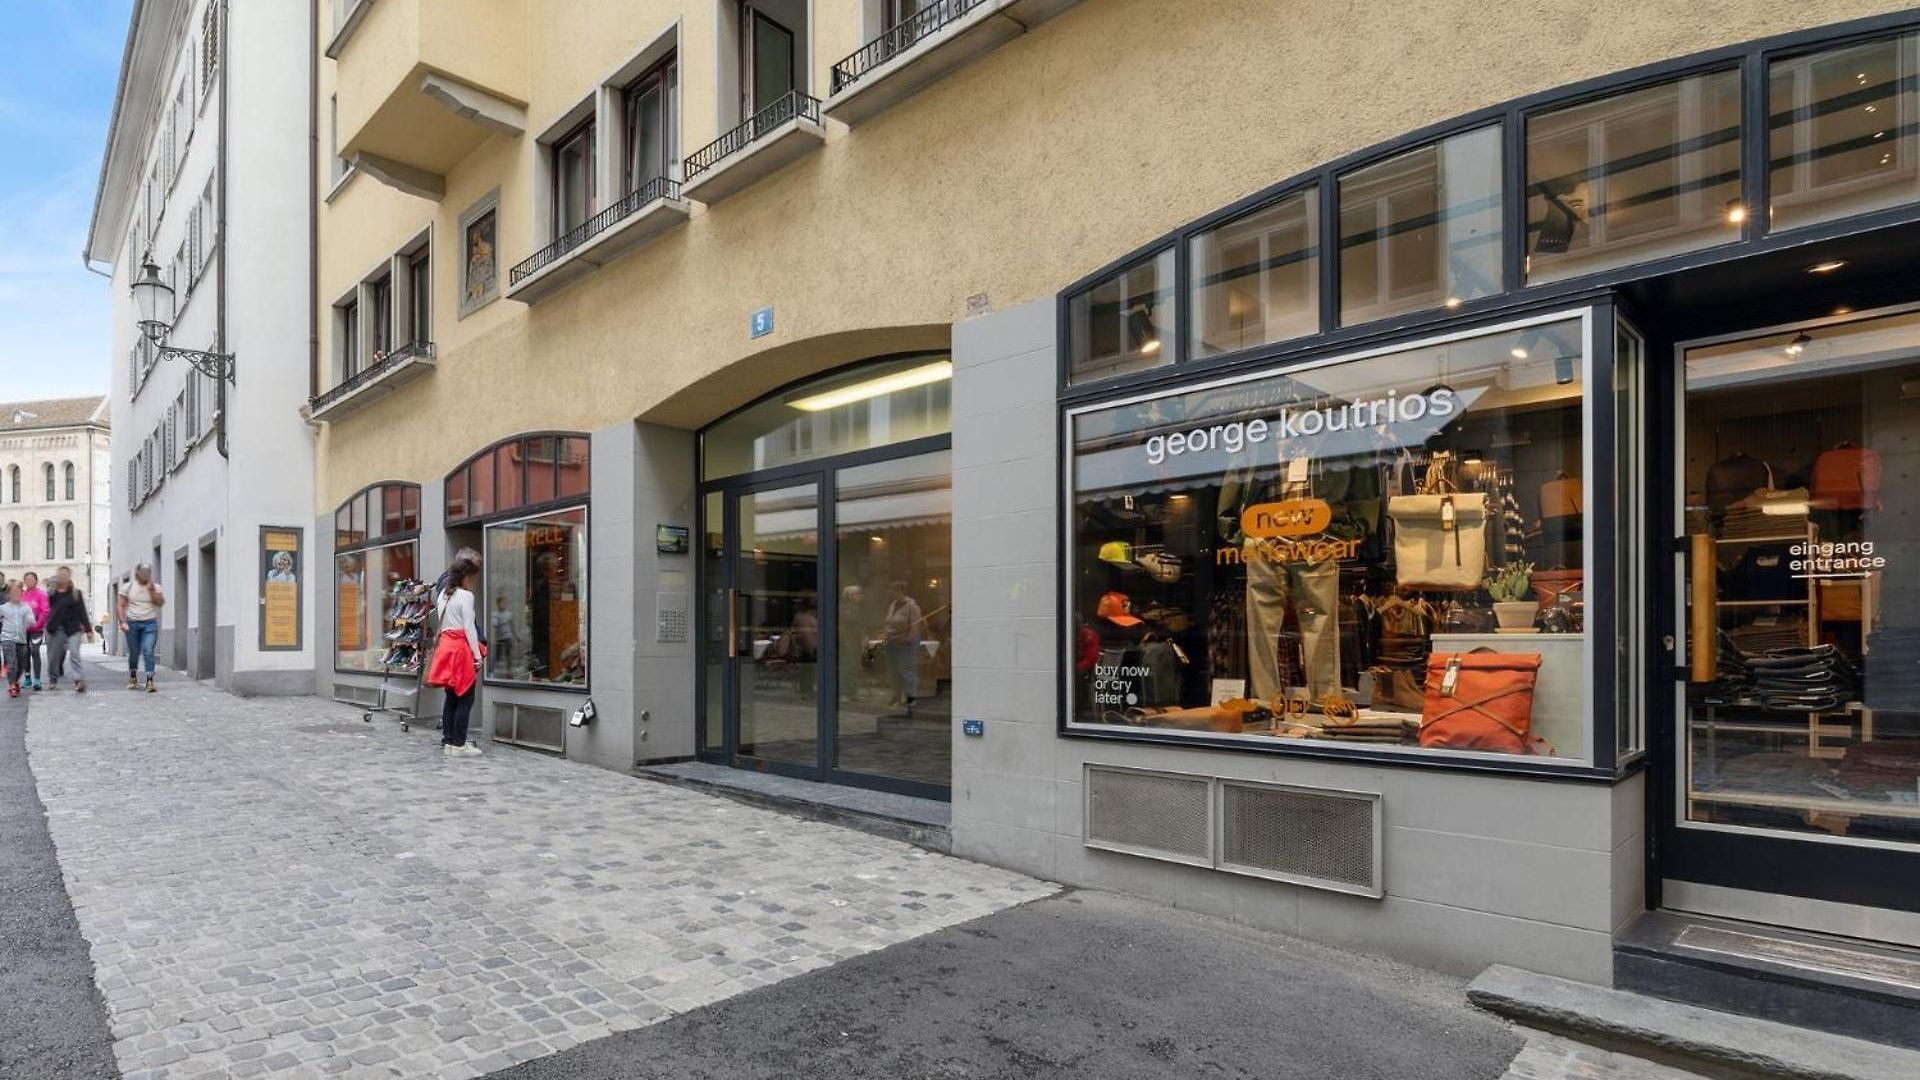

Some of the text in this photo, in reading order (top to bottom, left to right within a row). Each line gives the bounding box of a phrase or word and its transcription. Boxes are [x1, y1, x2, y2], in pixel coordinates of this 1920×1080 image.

[757, 313, 765, 331] 5
[1146, 388, 1455, 465] george koutrios
[1256, 507, 1314, 529] new
[1789, 541, 1873, 557] eingang
[1789, 556, 1886, 572] entrance
[1095, 663, 1150, 679] buy now
[1095, 679, 1132, 693] or cry
[1095, 692, 1123, 704] later
